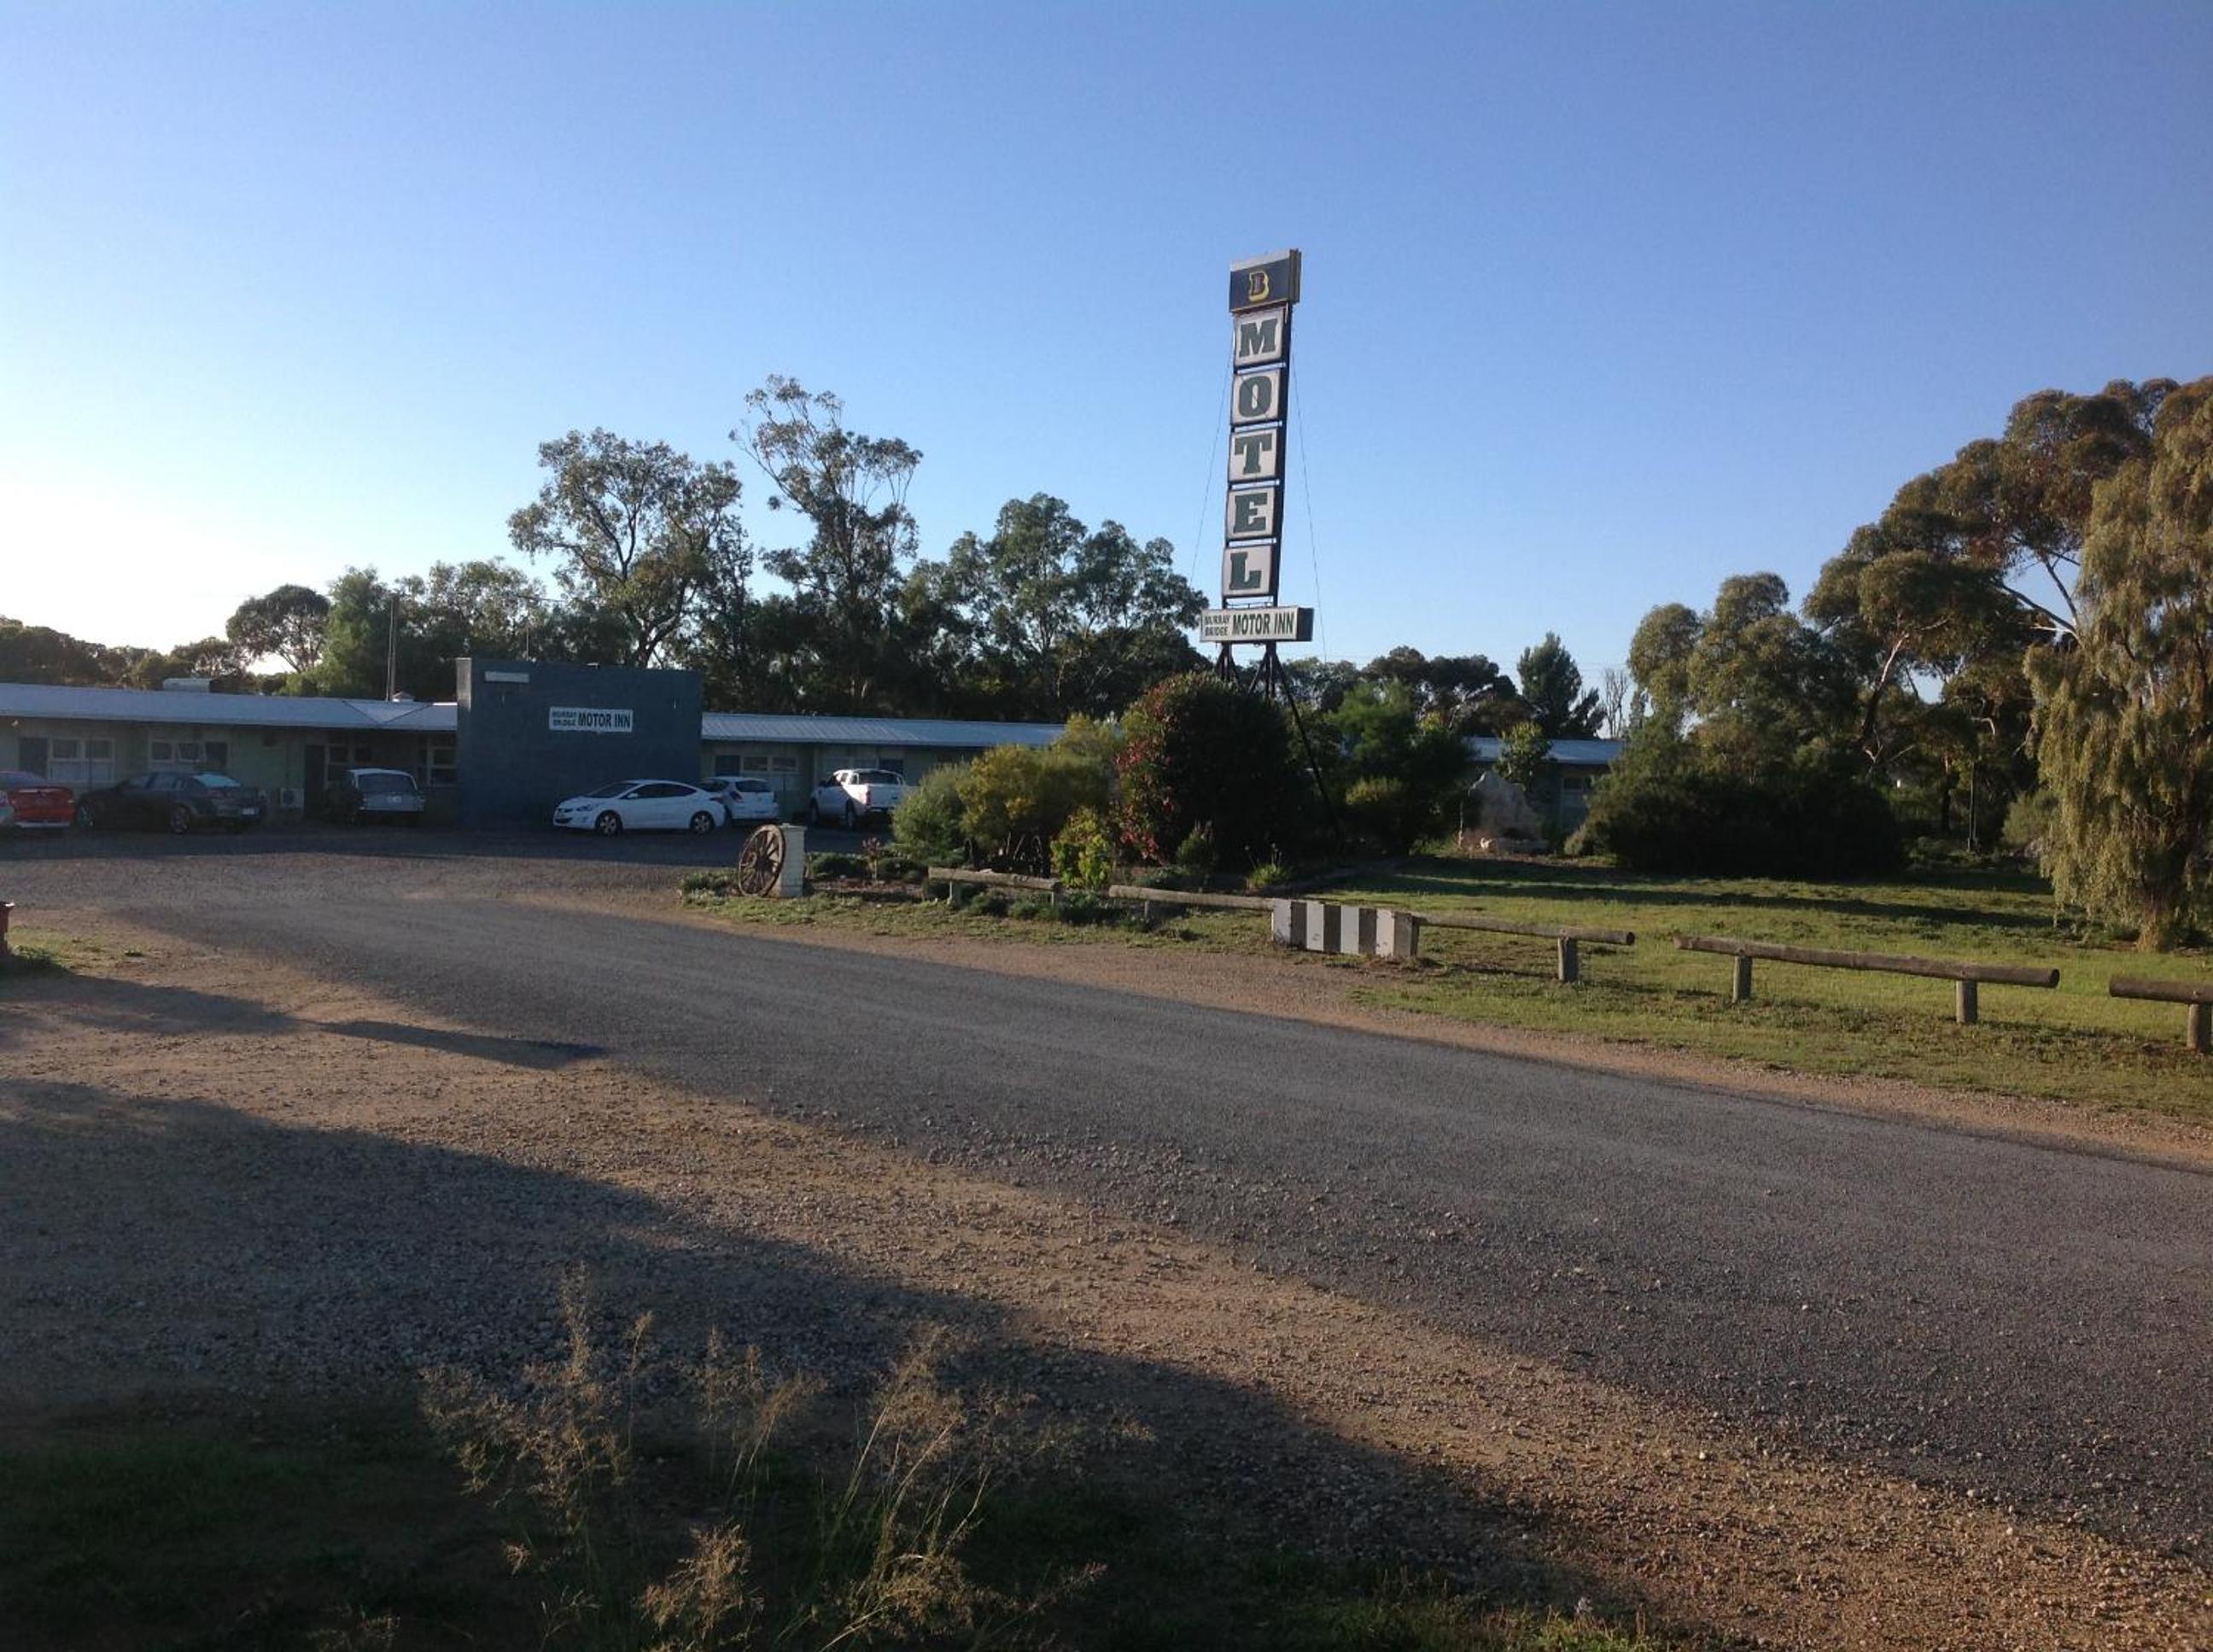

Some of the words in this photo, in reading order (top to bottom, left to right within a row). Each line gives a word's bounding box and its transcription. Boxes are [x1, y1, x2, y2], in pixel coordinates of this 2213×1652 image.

[1229, 318, 1277, 591] MOTEL
[1205, 615, 1230, 624] MURRAY
[1233, 613, 1270, 635] MOTOR
[1274, 612, 1294, 633] INN
[578, 712, 611, 727] MOTOR
[616, 714, 631, 728] INN
